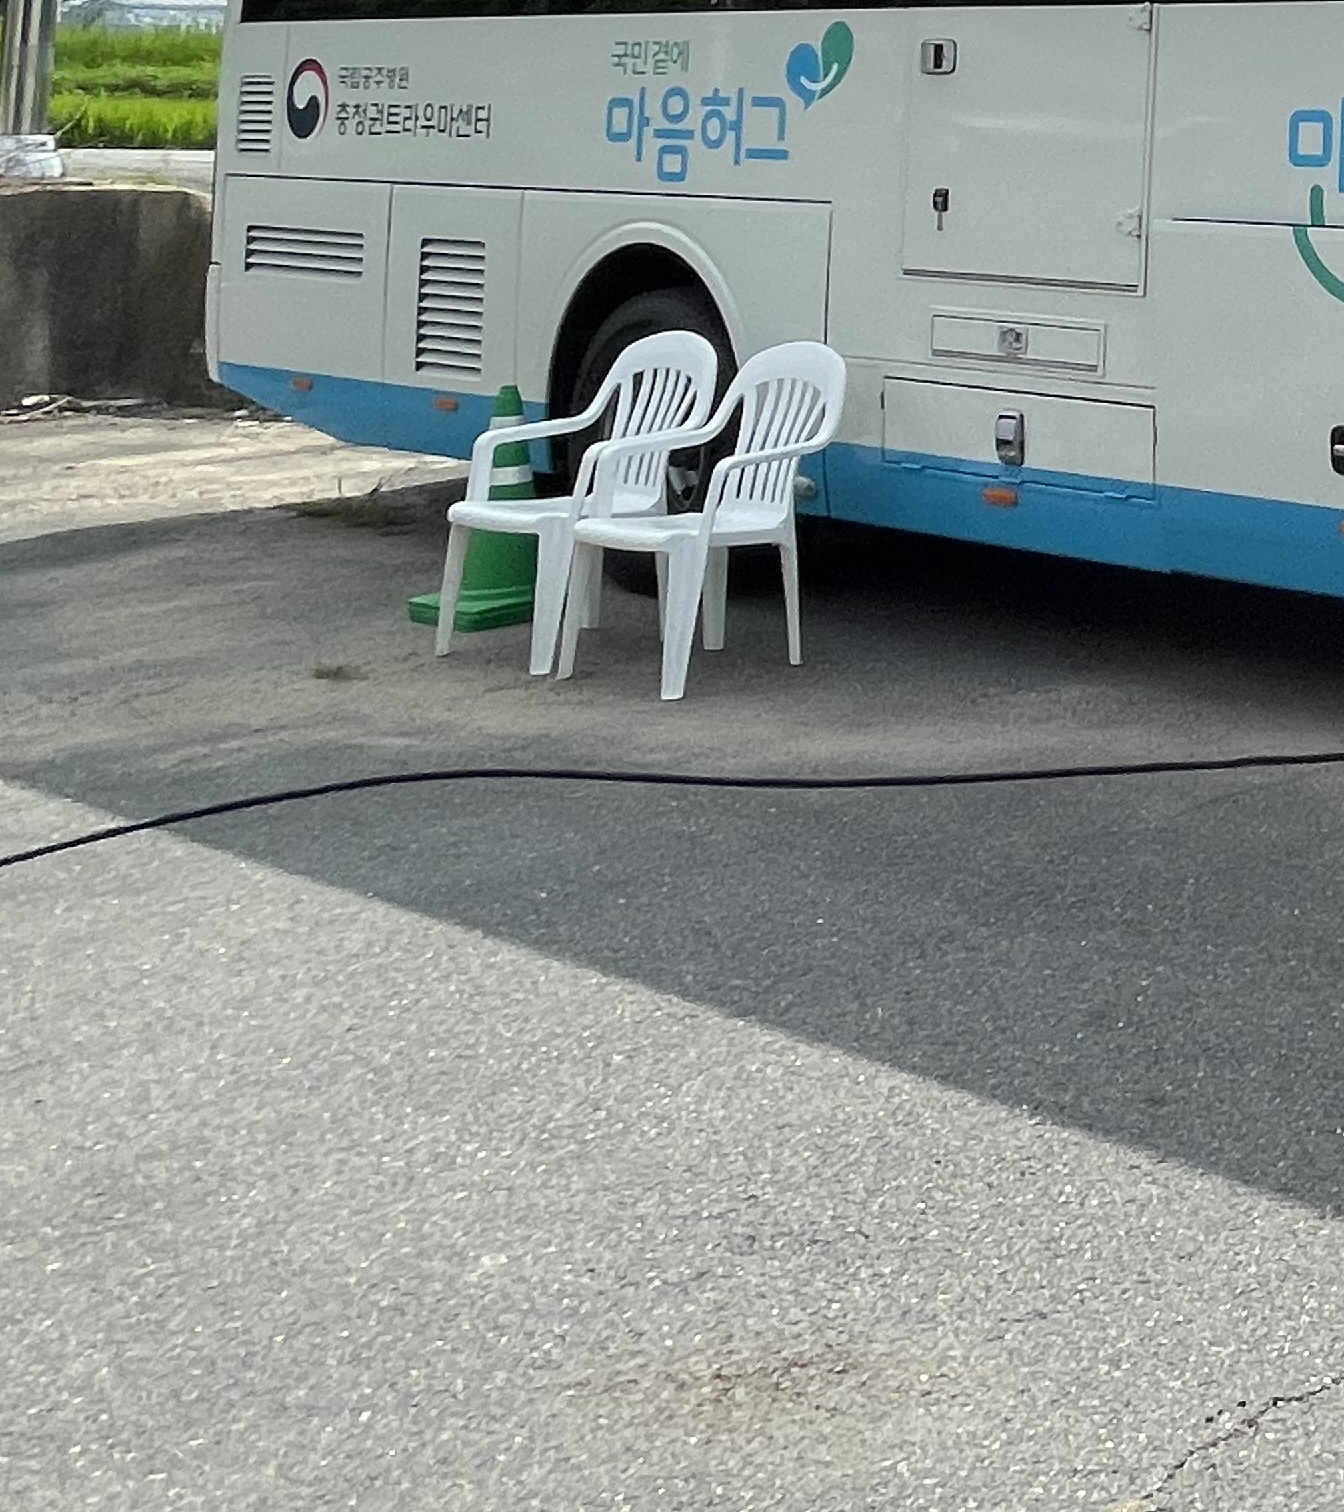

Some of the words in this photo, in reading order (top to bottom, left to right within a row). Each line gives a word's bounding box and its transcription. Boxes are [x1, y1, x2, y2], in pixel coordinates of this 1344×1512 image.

[611, 40, 690, 75] 국민곁에
[338, 66, 409, 90] 국립공주병원
[335, 100, 492, 139] 충청권트라우마센터
[606, 86, 790, 182] 마음허그
